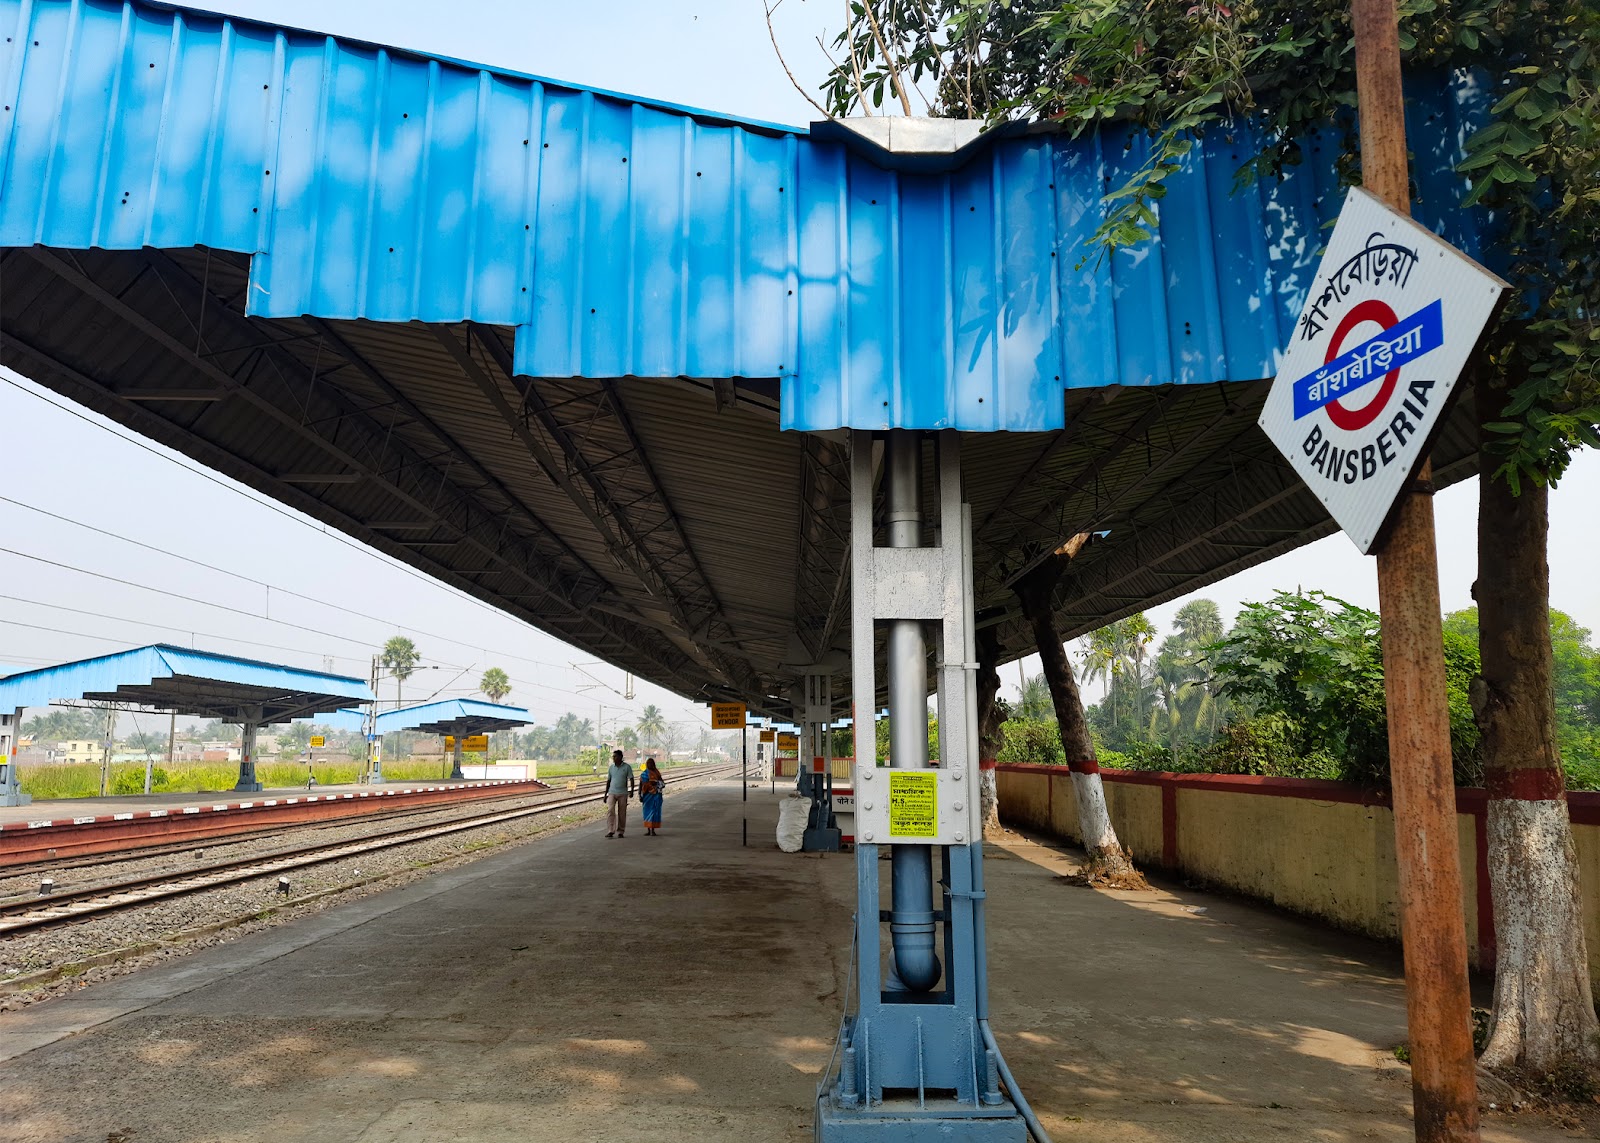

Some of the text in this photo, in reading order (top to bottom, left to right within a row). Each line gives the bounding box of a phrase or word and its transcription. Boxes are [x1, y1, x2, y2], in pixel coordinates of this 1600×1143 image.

[1301, 232, 1419, 341] বাঁশবেড়িয়া
[1308, 324, 1423, 402] बाँशबेड़िया
[1302, 378, 1435, 485] BANSBERIA
